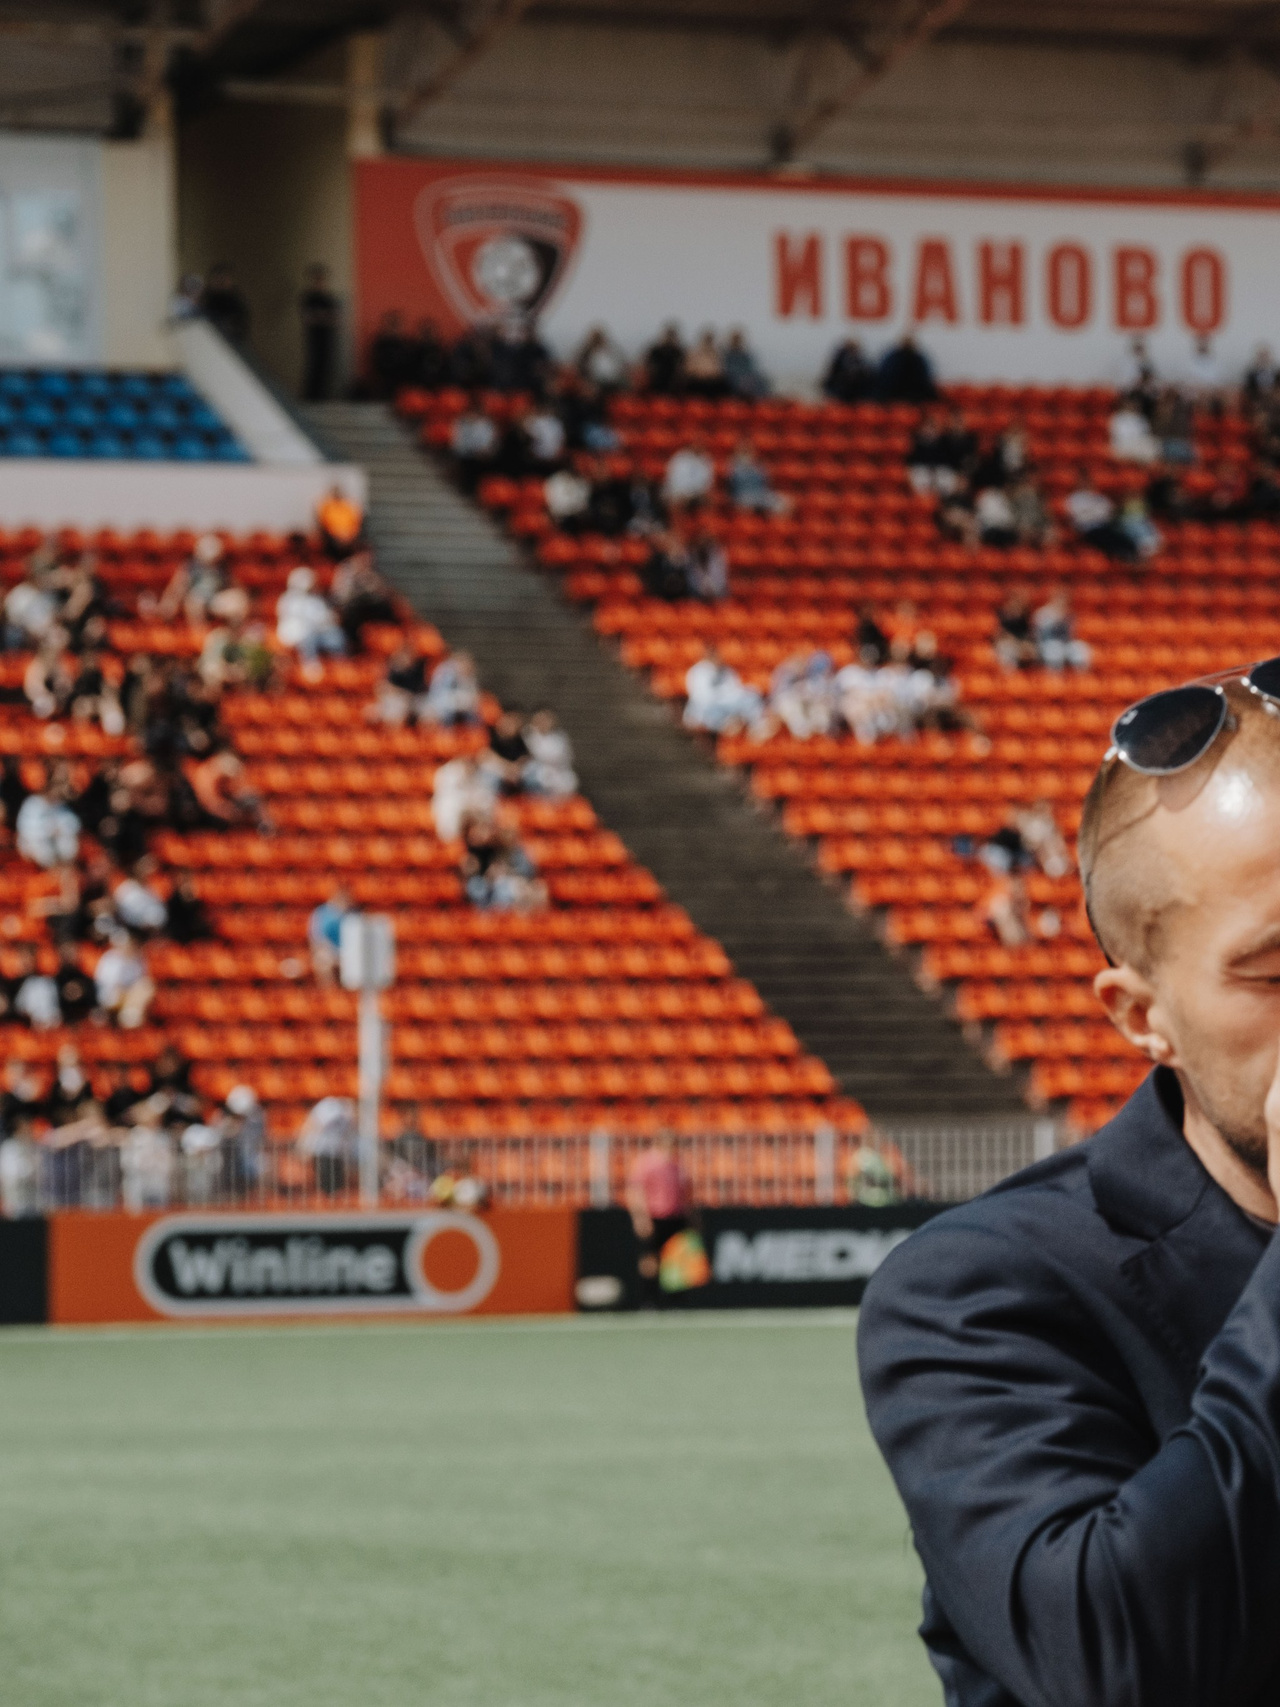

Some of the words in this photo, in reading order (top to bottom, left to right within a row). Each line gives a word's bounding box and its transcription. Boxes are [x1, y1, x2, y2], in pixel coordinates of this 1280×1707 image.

[774, 229, 1227, 334] ИВАНОВО
[168, 1239, 396, 1293] Winline
[717, 1229, 913, 1280] MEDI
